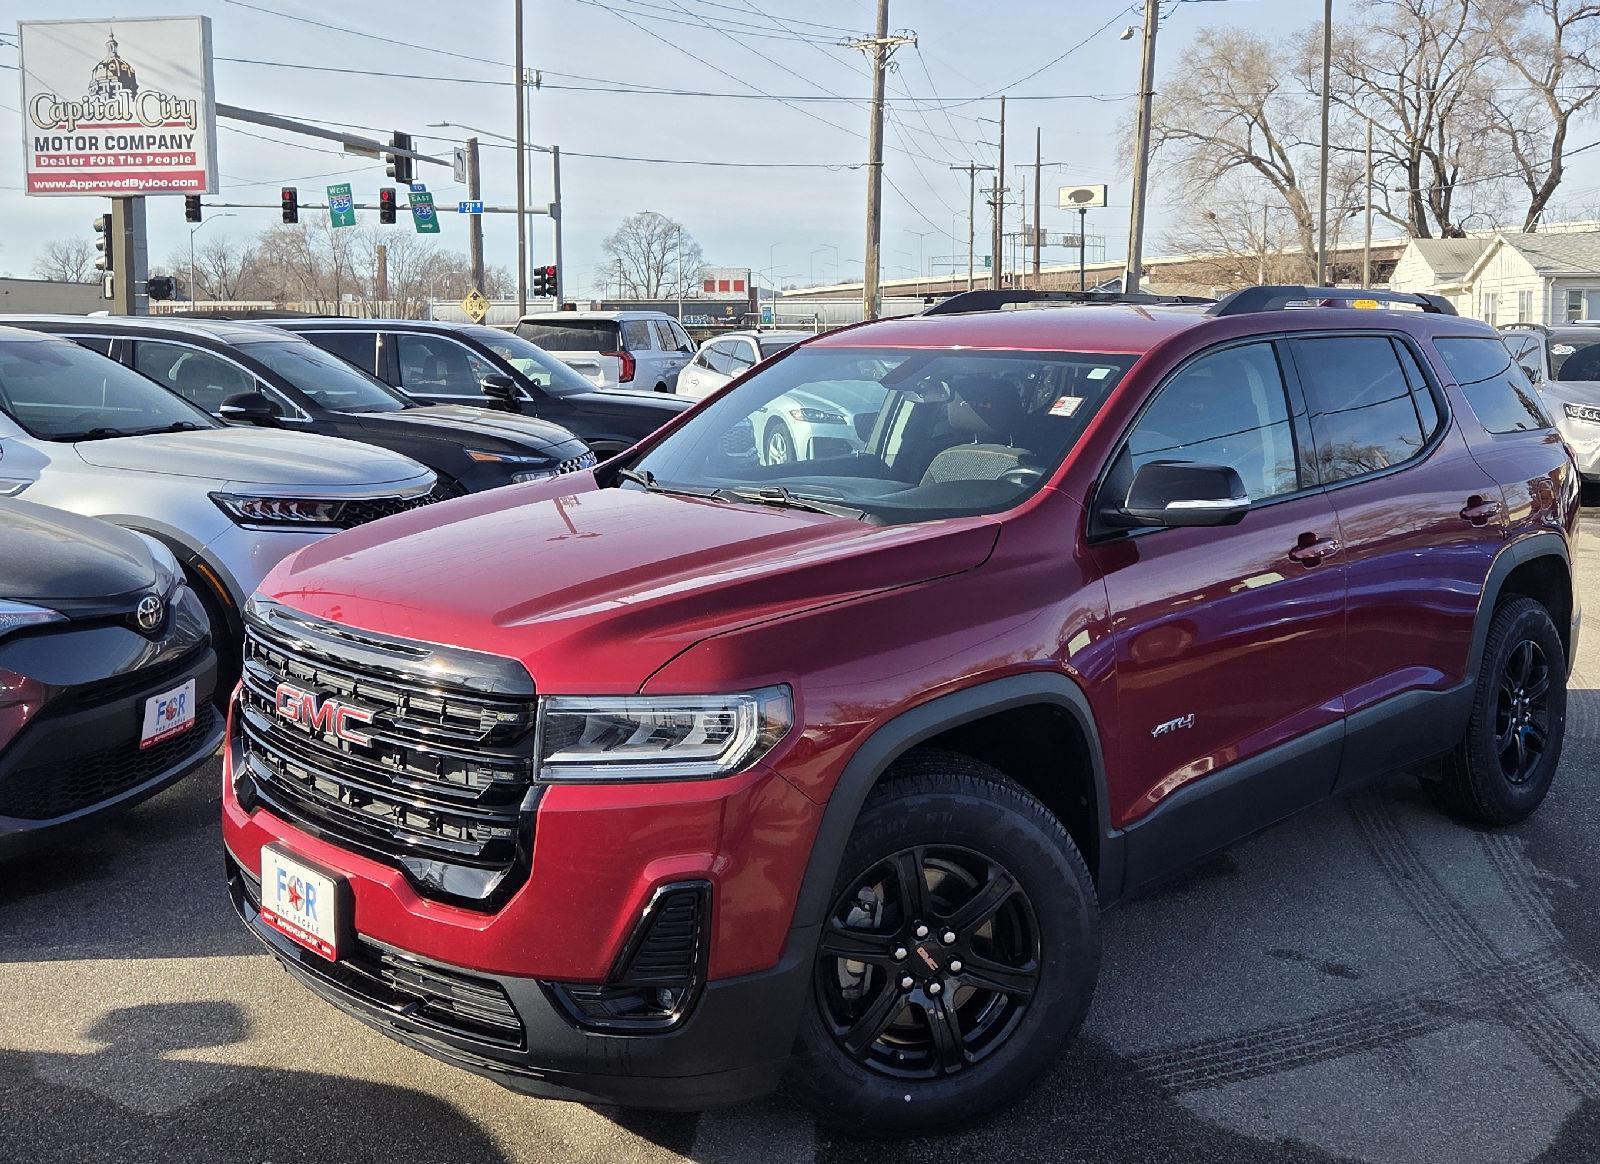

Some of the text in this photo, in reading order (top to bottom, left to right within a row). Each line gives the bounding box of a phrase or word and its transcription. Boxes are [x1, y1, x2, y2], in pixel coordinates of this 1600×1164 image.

[30, 90, 197, 132] Capital City
[34, 134, 194, 152] MOTOR COMPANY
[40, 153, 192, 167] Dealer FOR The People
[33, 177, 199, 190] www.ApprovedByJoe.com
[329, 186, 348, 194] WEST
[332, 199, 350, 209] 235
[416, 206, 433, 216] 235
[276, 682, 374, 748] GMC
[1151, 713, 1195, 738] AT4
[276, 867, 319, 922] FOR
